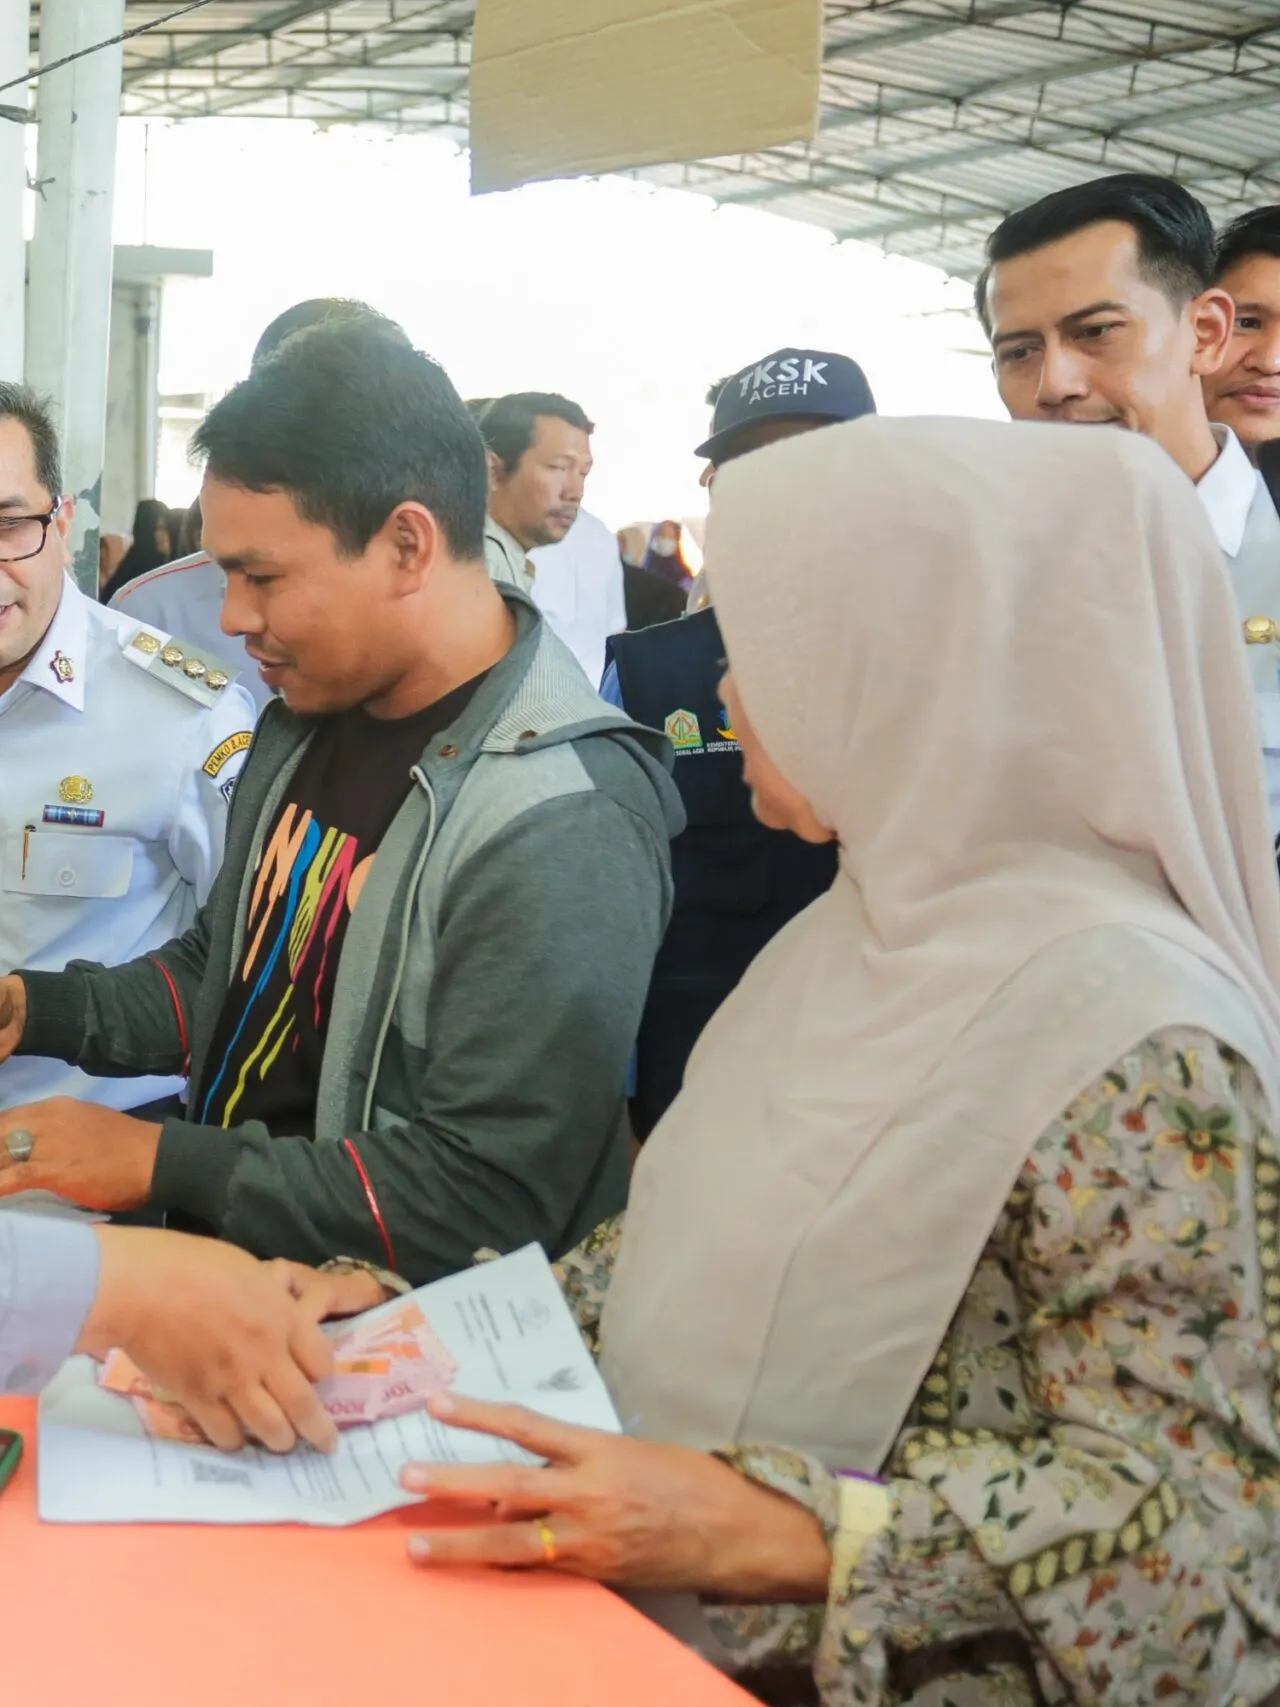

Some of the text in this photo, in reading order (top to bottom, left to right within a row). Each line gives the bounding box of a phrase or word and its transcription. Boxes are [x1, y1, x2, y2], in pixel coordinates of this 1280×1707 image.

[739, 357, 829, 398] TKSK
[748, 381, 808, 405] ACEH
[207, 744, 231, 773] PEMKO
